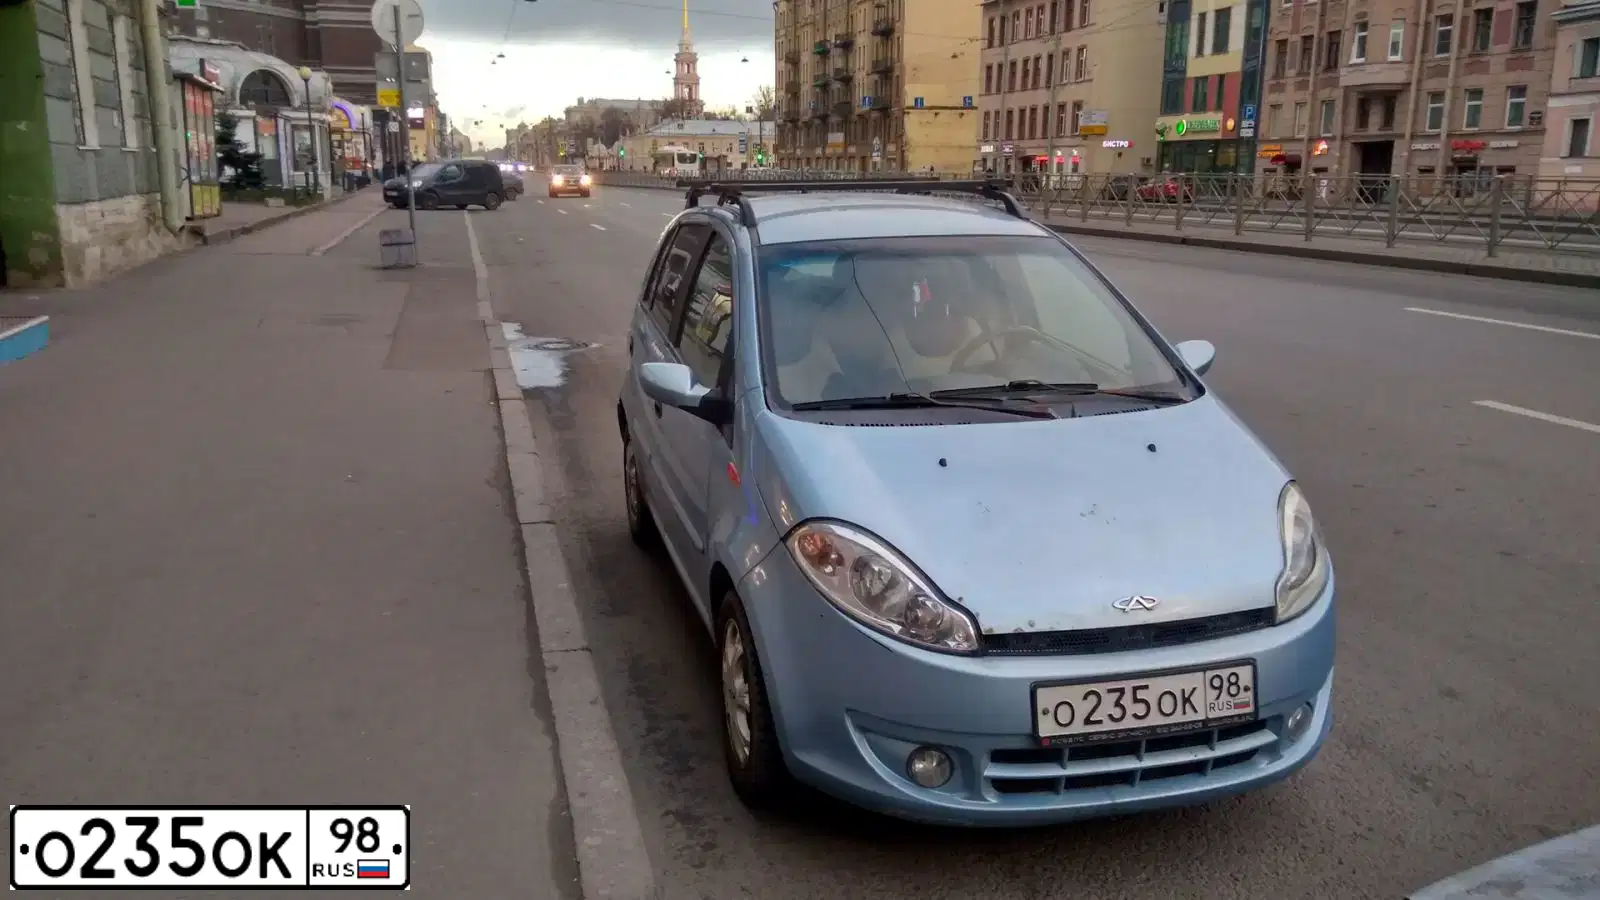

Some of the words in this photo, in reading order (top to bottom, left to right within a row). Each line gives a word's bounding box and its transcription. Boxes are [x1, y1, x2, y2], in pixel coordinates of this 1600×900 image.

[1245, 106, 1253, 119] P
[1102, 140, 1129, 148] БИСТРО
[1209, 671, 1241, 701] 98
[1208, 700, 1233, 713] RUS
